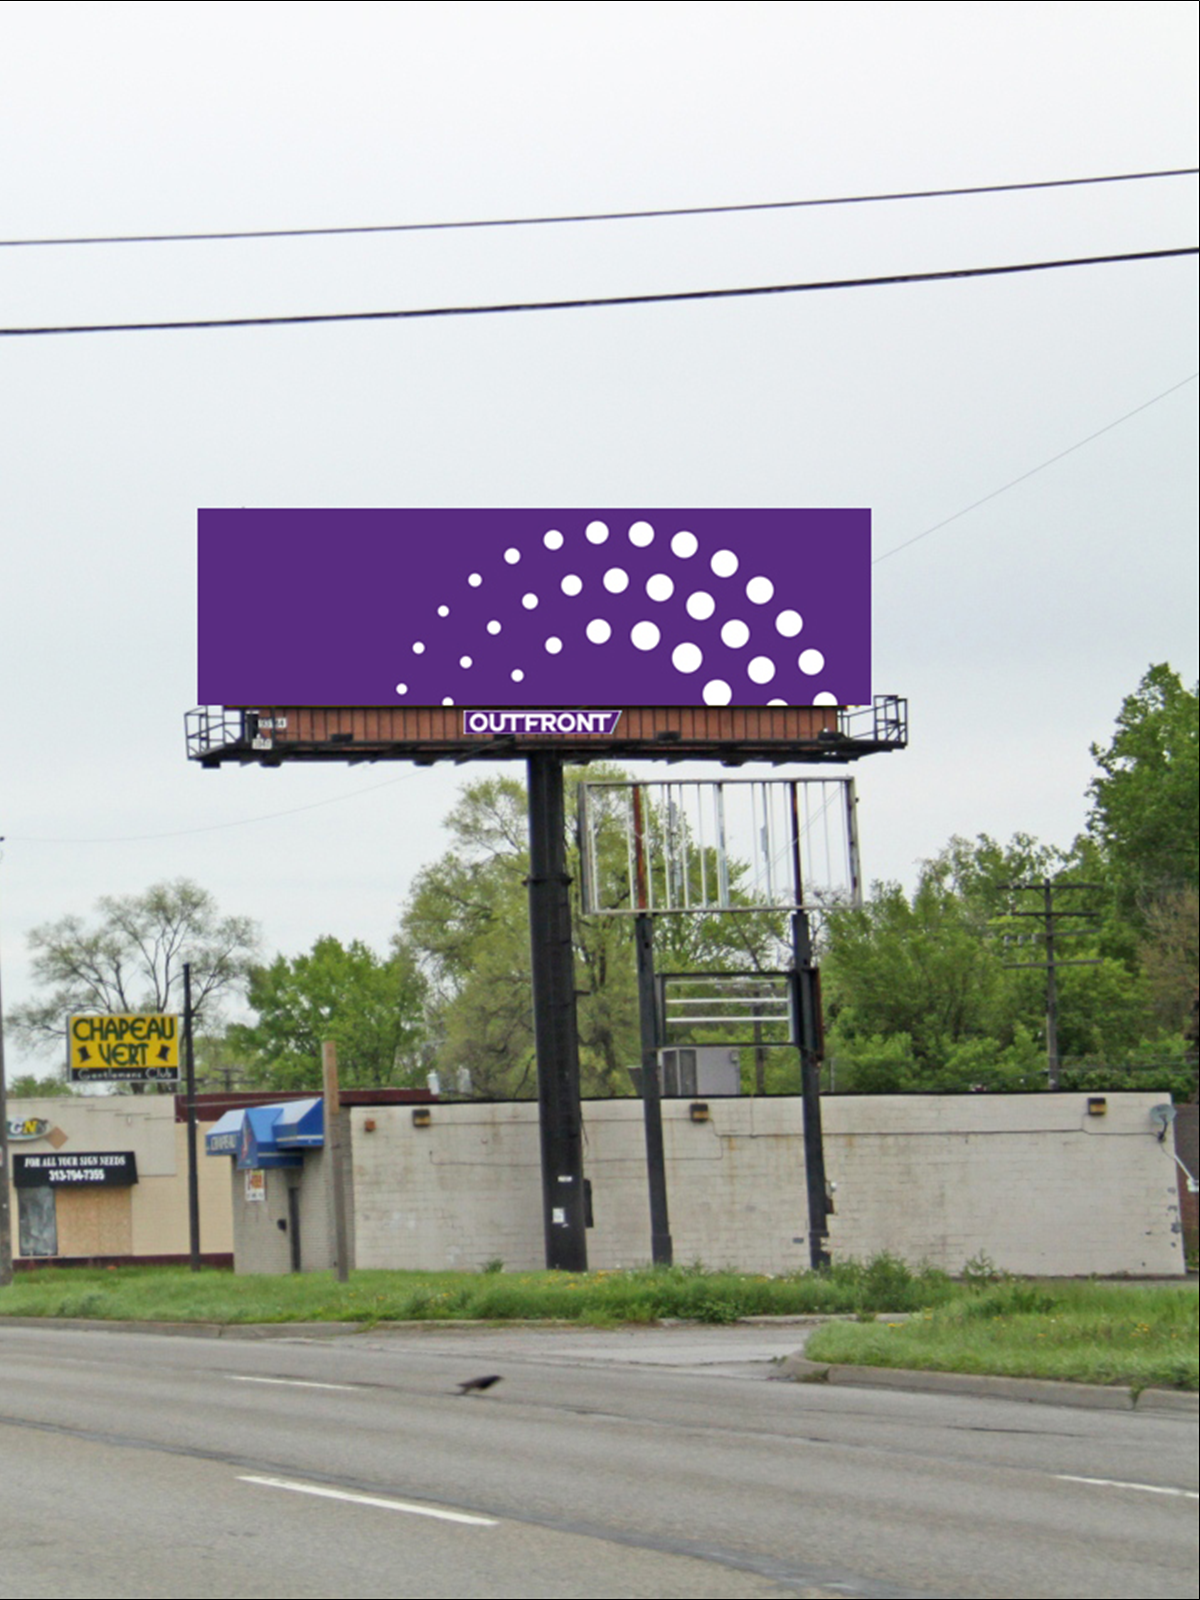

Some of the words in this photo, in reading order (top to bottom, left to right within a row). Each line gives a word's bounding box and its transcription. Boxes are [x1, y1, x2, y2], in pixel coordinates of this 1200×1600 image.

[469, 713, 612, 732] OUTFRONT
[73, 1017, 175, 1042] CHAPEAU
[98, 1042, 149, 1067] VERT
[145, 1066, 173, 1080] Club
[24, 1157, 40, 1168] FOR
[42, 1157, 57, 1167] ALL
[58, 1156, 78, 1167] YOUR
[79, 1156, 99, 1166] SIGN
[100, 1155, 126, 1166] NEEDS
